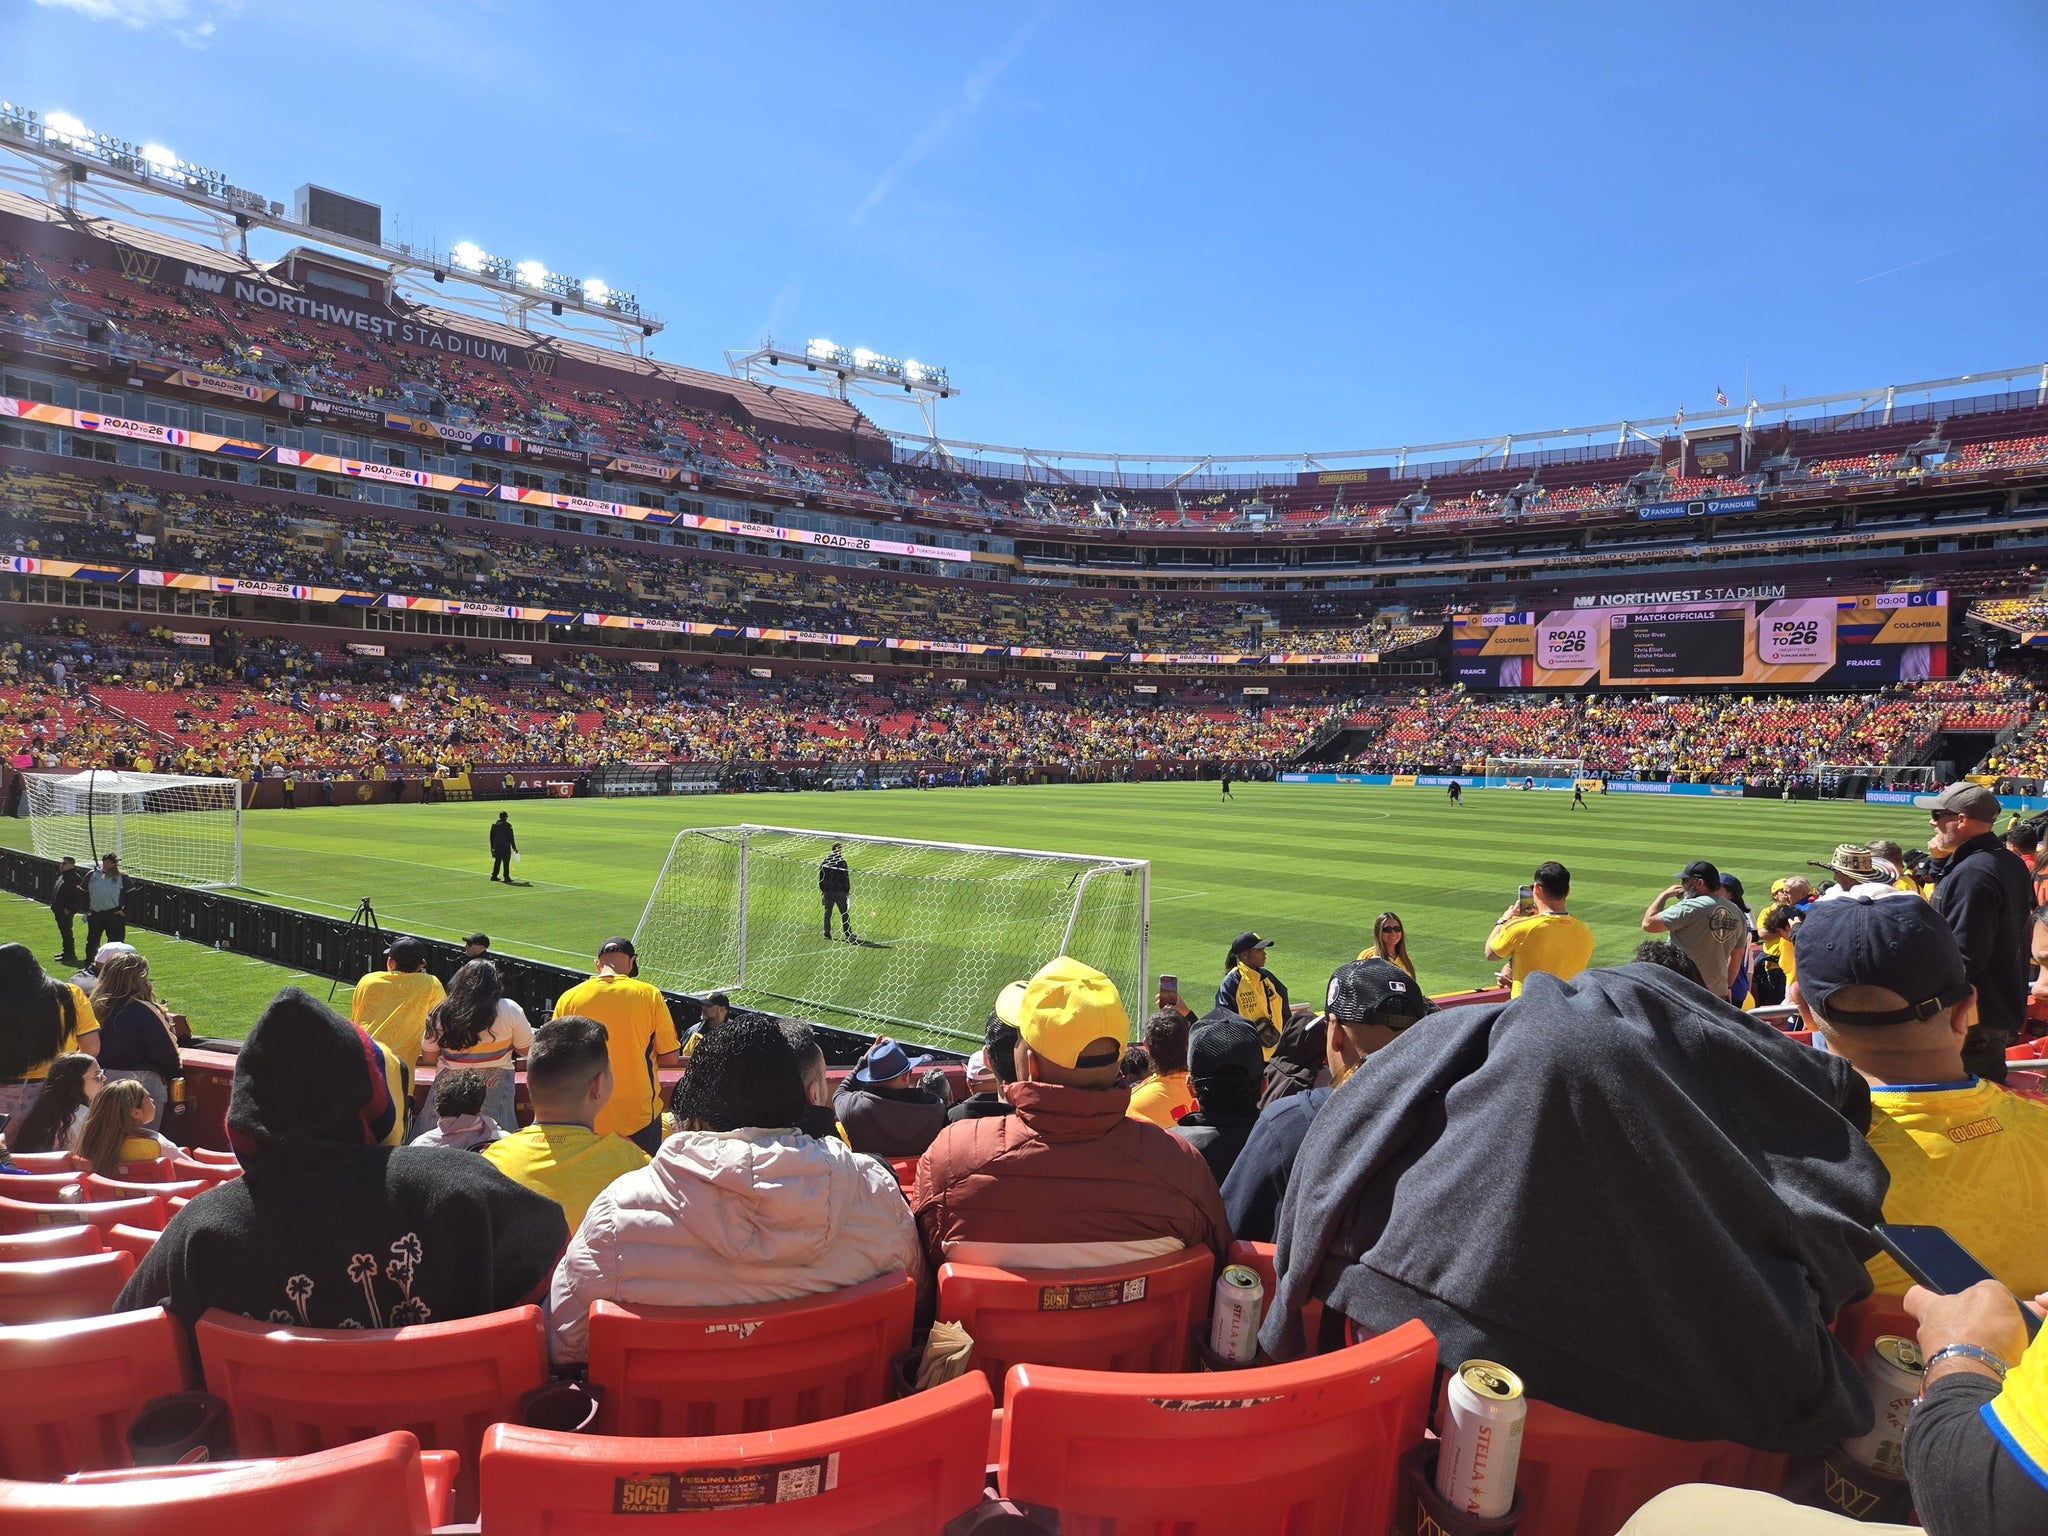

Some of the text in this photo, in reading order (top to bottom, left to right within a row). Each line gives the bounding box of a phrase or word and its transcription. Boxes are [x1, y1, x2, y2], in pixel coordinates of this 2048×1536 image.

[184, 268, 508, 363] NW NORTHWEST STADIUM
[311, 401, 378, 419] NW NORTHWEST
[104, 418, 138, 431] ROAD
[149, 426, 163, 435] 26
[420, 422, 492, 445] 0 00:00 0
[527, 444, 544, 454] NW
[544, 447, 583, 458] NORTHWEST
[365, 464, 392, 475] ROAD
[1318, 472, 1368, 484] COMMANDERS
[572, 499, 594, 507] ROAD
[600, 502, 609, 510] 26
[1720, 501, 1756, 510] FANDUEL
[742, 524, 761, 532] ROAD
[814, 534, 846, 547] ROAD
[856, 540, 870, 549] 26
[1578, 554, 1617, 562] WORLD
[1619, 549, 1684, 558] CHAMPIONS
[238, 581, 268, 590] ROAD
[1573, 585, 1785, 607] NW NORTHWEST STADIUM
[1877, 597, 1905, 605] 00:00
[1913, 596, 1921, 604] 0
[464, 603, 488, 611] ROAD
[1668, 612, 1715, 620] OFFICIALS
[1773, 621, 1818, 632] ROAD
[1893, 621, 1941, 629] COLOMBIA
[1549, 631, 1586, 640] ROAD
[1846, 659, 1882, 667] FRANCE
[560, 786, 568, 794] G
[1628, 783, 1671, 792] THROUGHOUT
[1948, 1117, 2003, 1143] COLOMBIA
[1230, 1304, 1242, 1338] STELLA
[1472, 1425, 1492, 1481] STELLA
[728, 1474, 770, 1482] LUCKY?
[622, 1504, 668, 1512] RAFFLE
